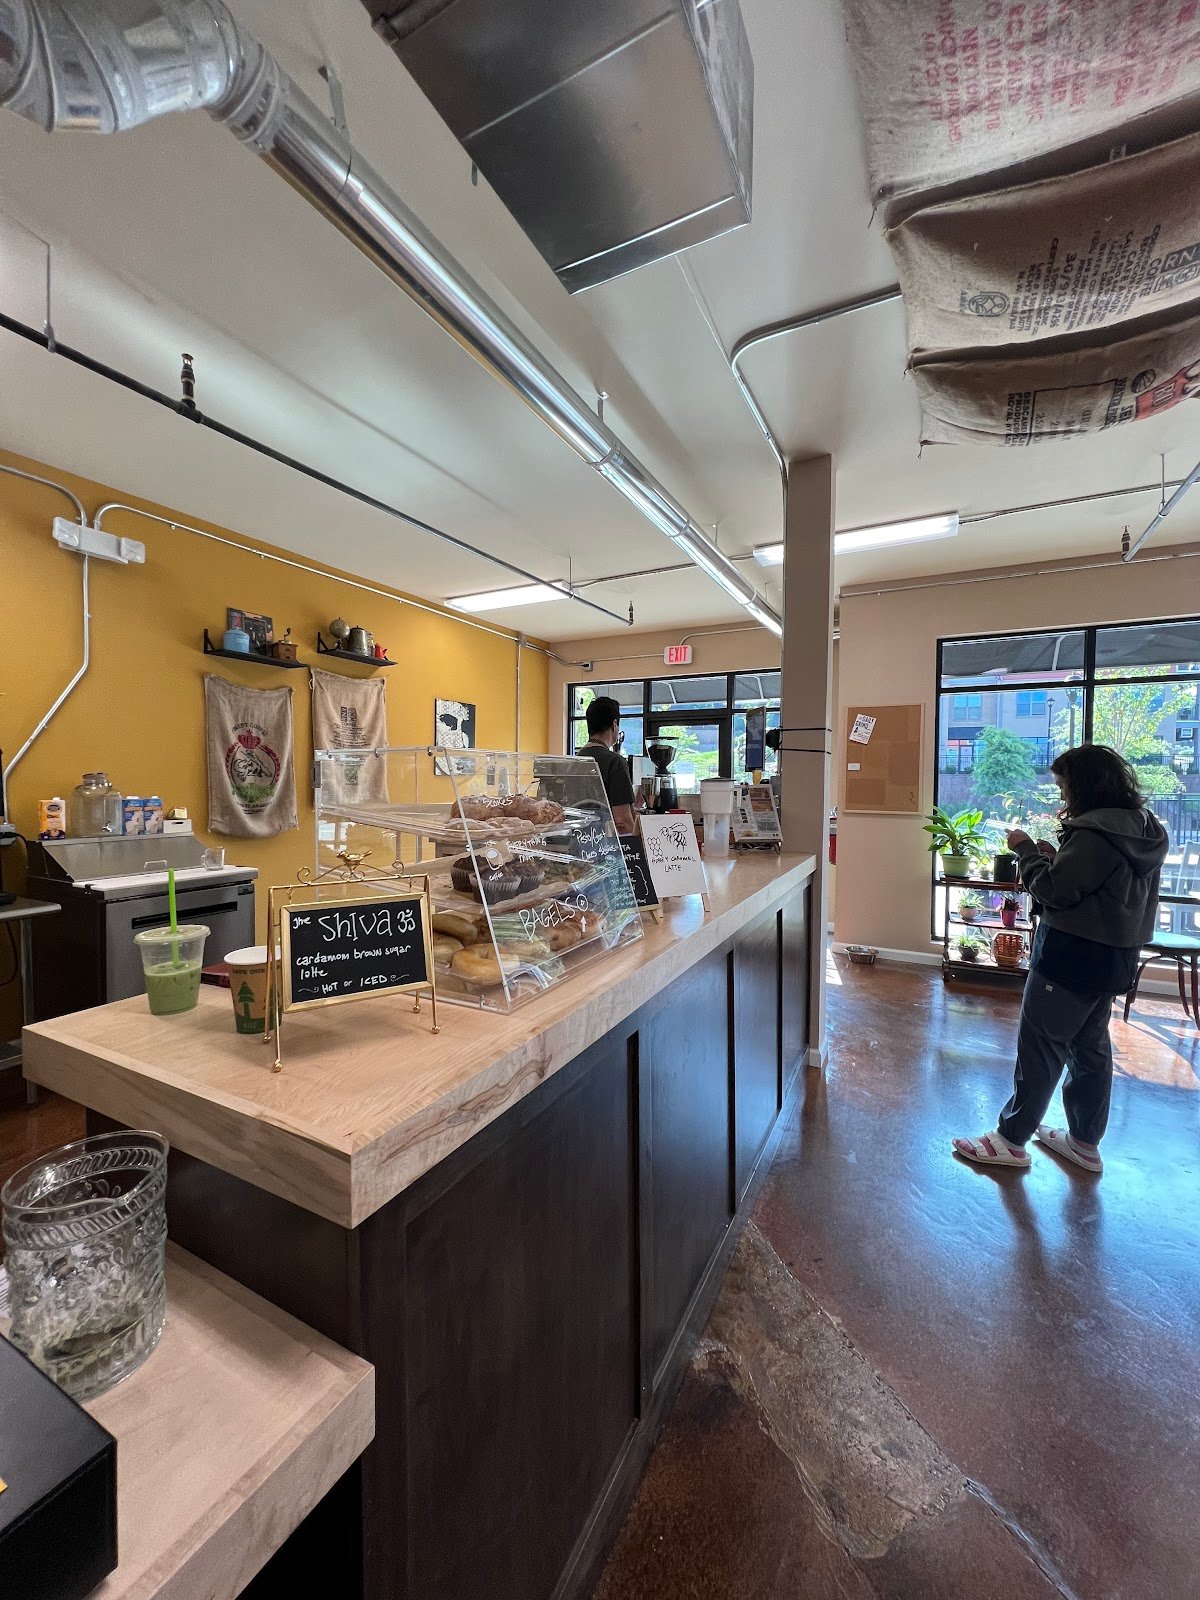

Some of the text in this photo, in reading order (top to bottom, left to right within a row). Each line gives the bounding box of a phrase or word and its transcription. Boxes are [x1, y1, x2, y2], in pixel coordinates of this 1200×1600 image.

[669, 646, 688, 662] EXIT
[664, 863, 682, 873] LATTE
[518, 896, 576, 944] BAGELS
[295, 952, 350, 967] cardamom
[384, 944, 412, 957] sugar
[359, 974, 388, 987] ICED
